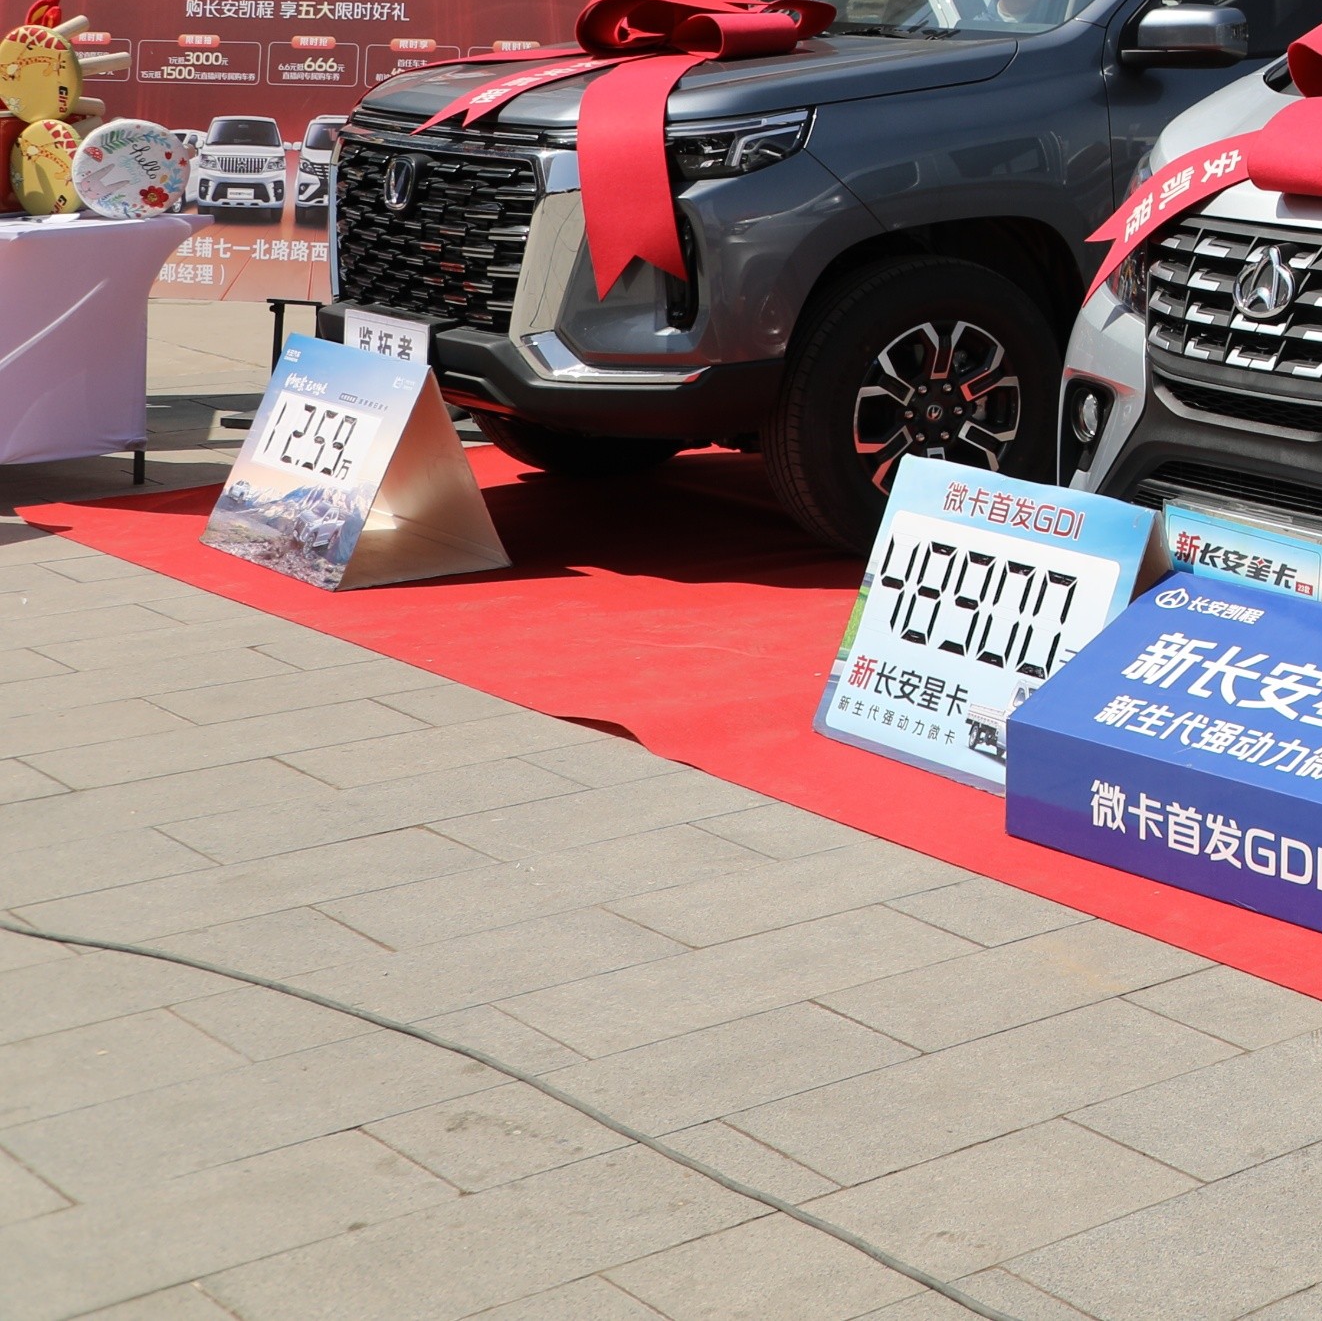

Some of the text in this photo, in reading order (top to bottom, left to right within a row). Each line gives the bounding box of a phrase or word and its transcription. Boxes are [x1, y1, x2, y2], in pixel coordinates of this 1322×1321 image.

[185, 0, 410, 22] 购长安凯程 享五大限时好礼
[129, 143, 161, 180] hello
[942, 481, 1086, 542] 微卡首发GDI
[1174, 531, 1298, 590] 新长安星卡
[880, 532, 1078, 680] 48900
[1187, 595, 1266, 626] 长安凯程
[848, 654, 969, 717] 新长安星卡
[836, 695, 957, 746] 新生代强动力微卡
